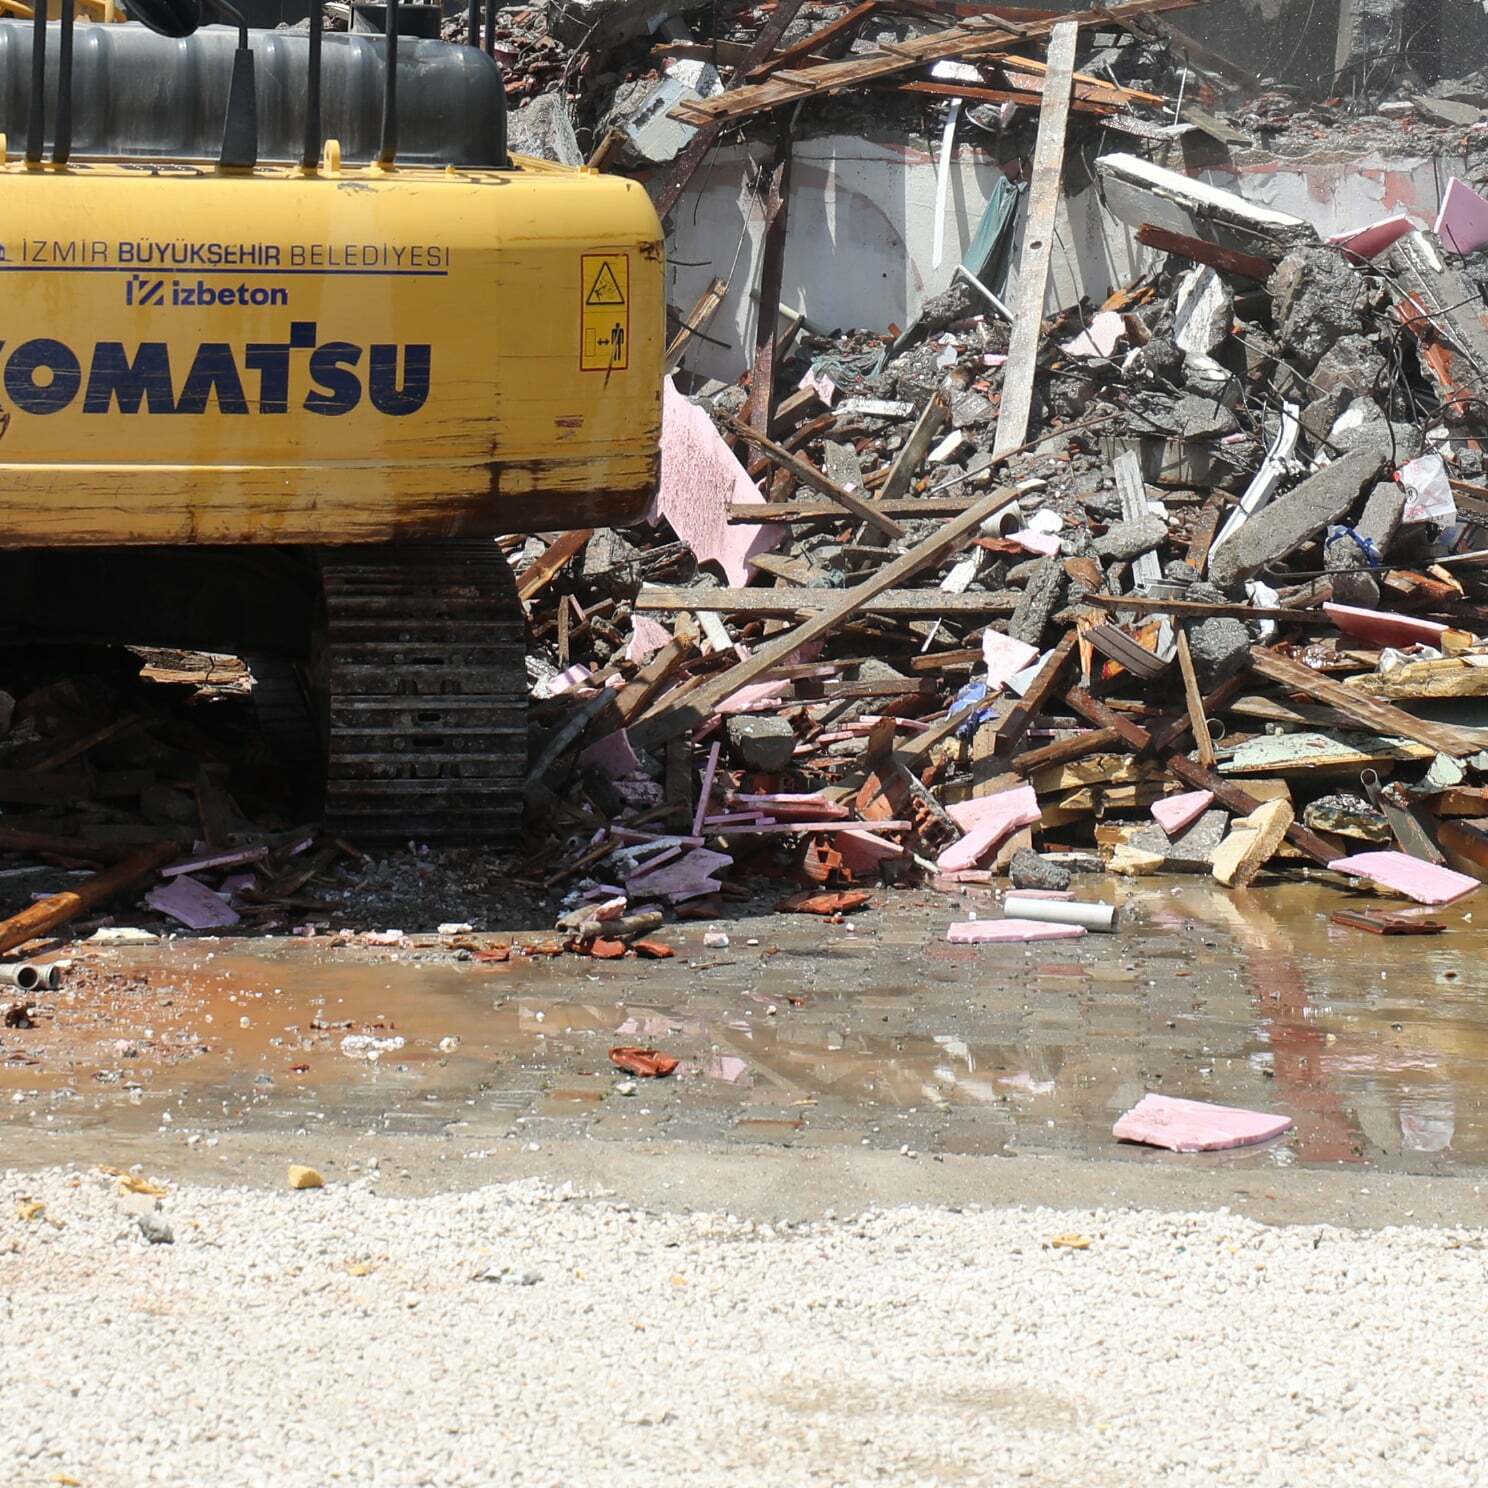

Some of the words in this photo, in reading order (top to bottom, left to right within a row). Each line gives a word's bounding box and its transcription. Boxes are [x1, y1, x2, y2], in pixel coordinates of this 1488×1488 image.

[22, 238, 109, 263] İZMİR
[118, 237, 281, 267] BÜYÜKŞEHİR
[172, 279, 289, 306] izbeton
